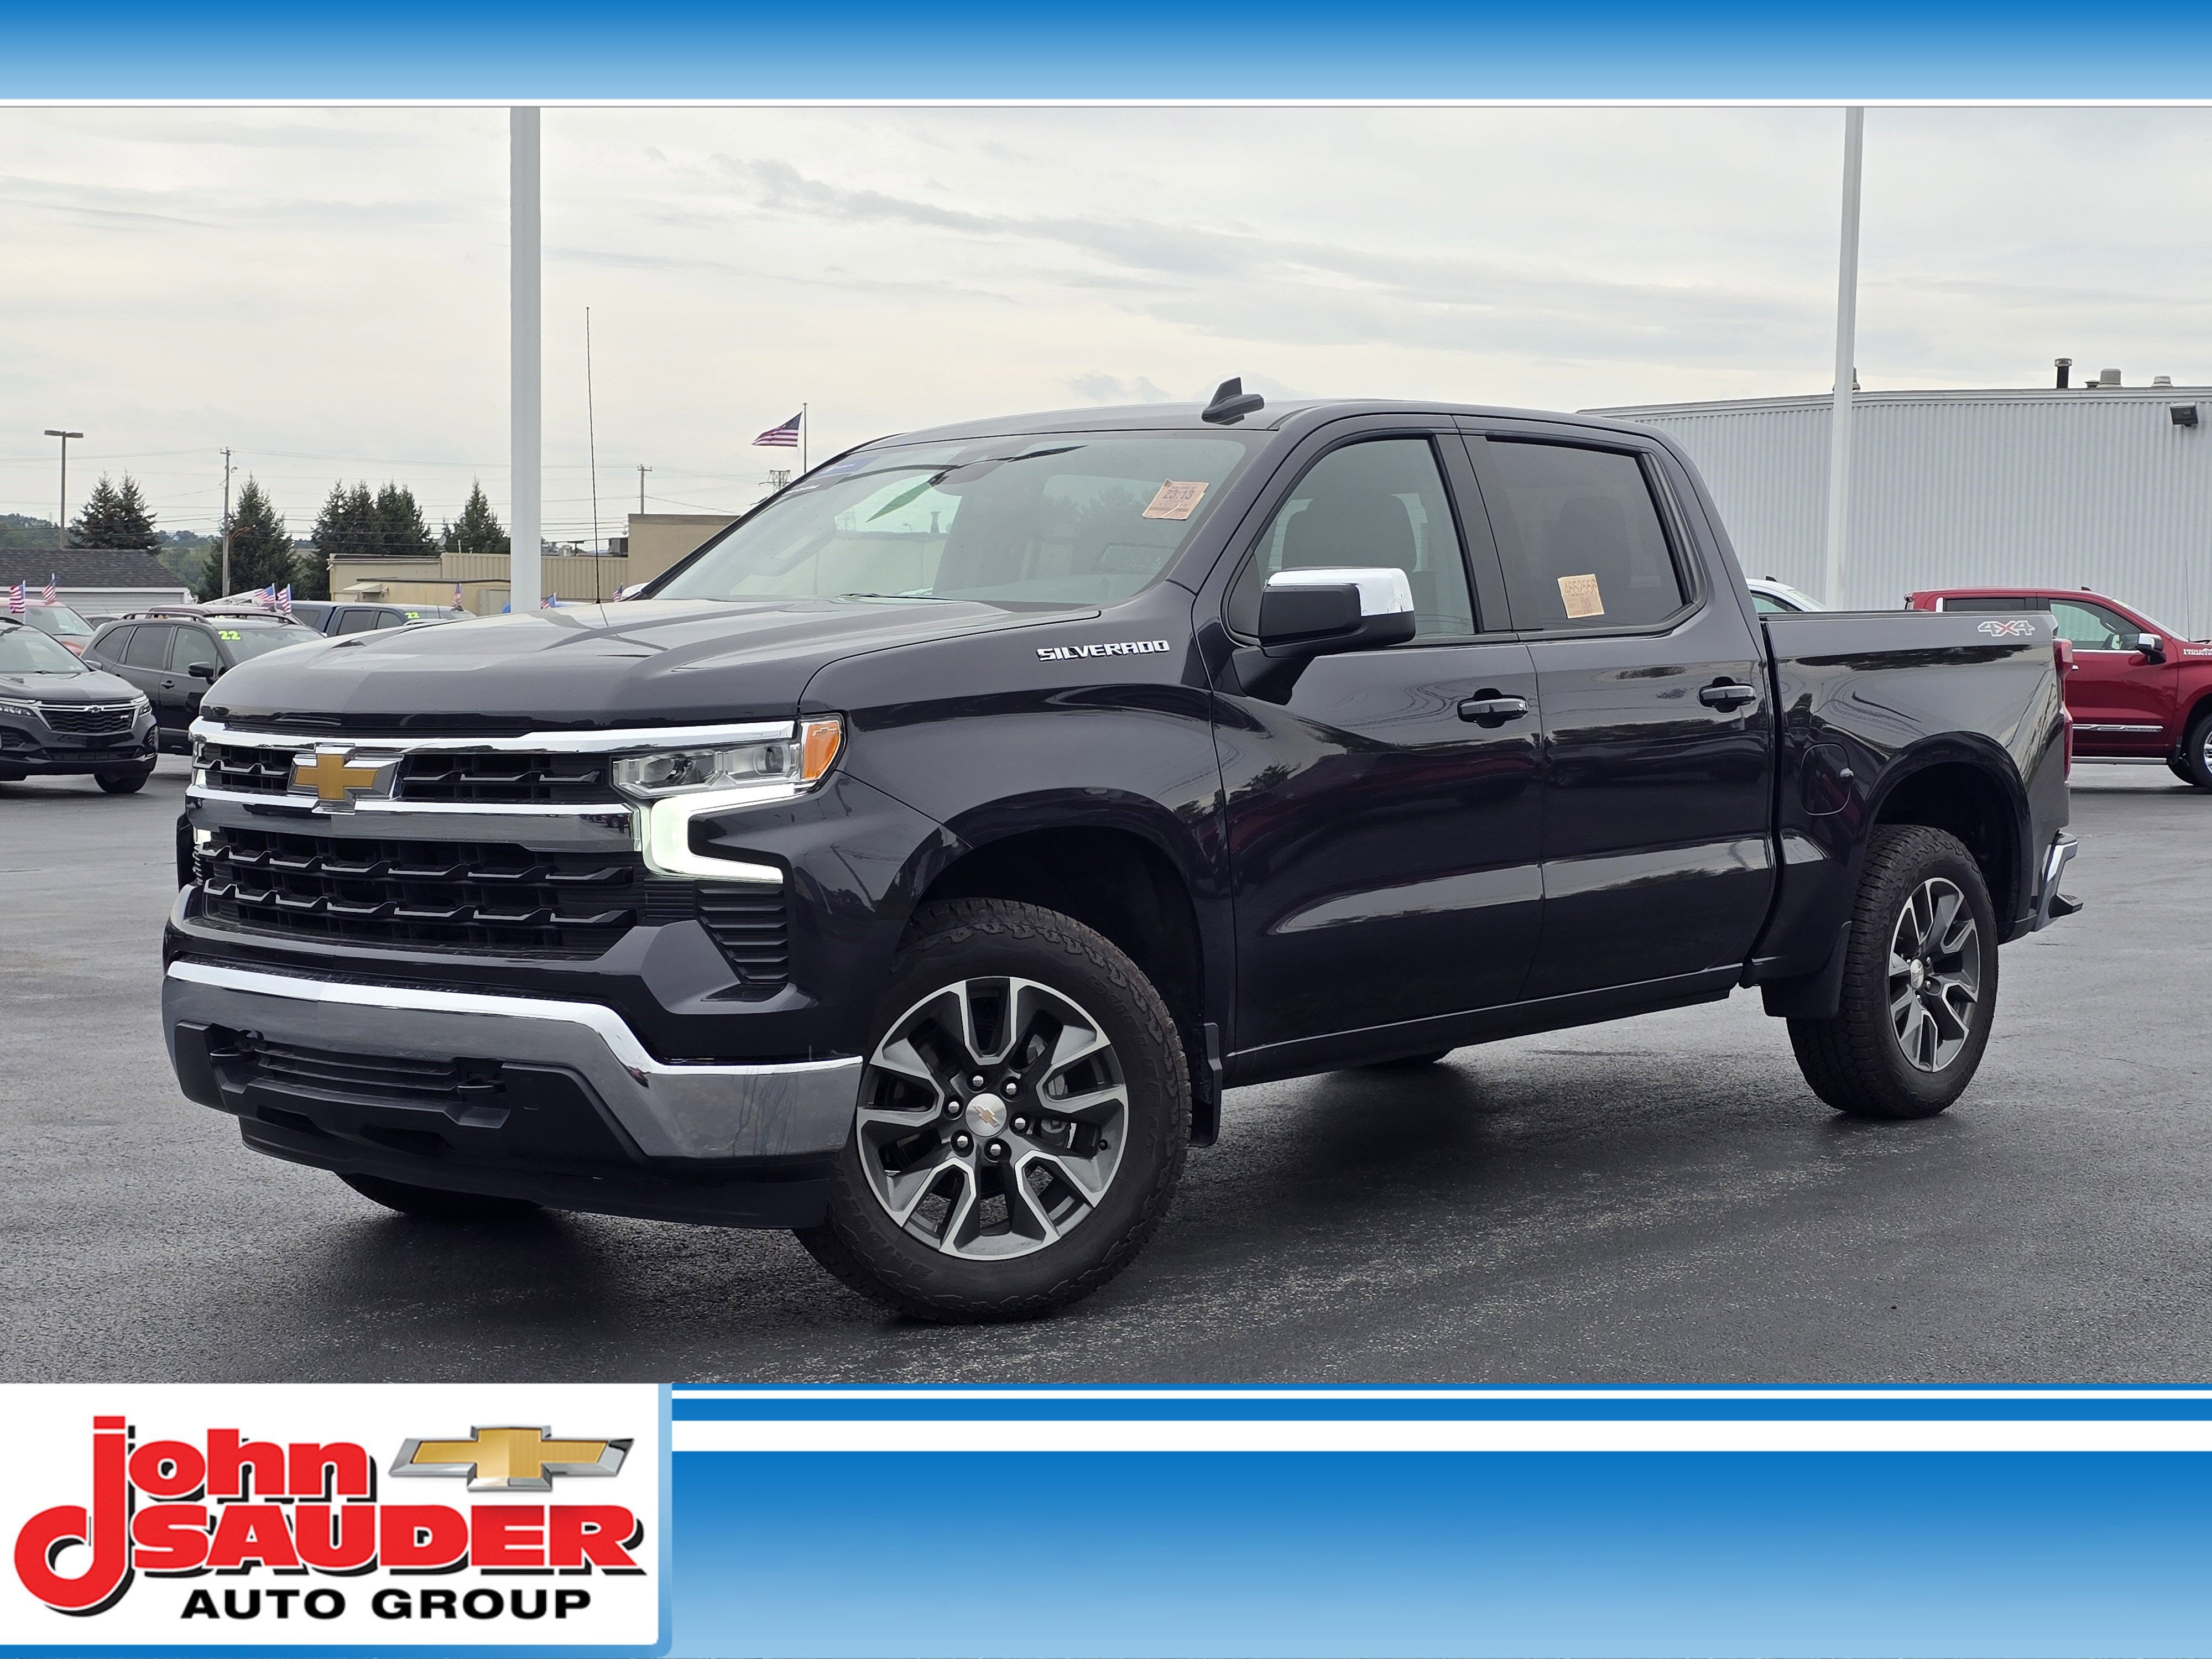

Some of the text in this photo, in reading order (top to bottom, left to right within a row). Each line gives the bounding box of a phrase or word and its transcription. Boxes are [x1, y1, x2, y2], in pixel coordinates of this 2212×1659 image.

[218, 630, 241, 640] 22
[1037, 640, 1170, 661] SILVERADO
[831, 1152, 933, 1280] BRIDGEST
